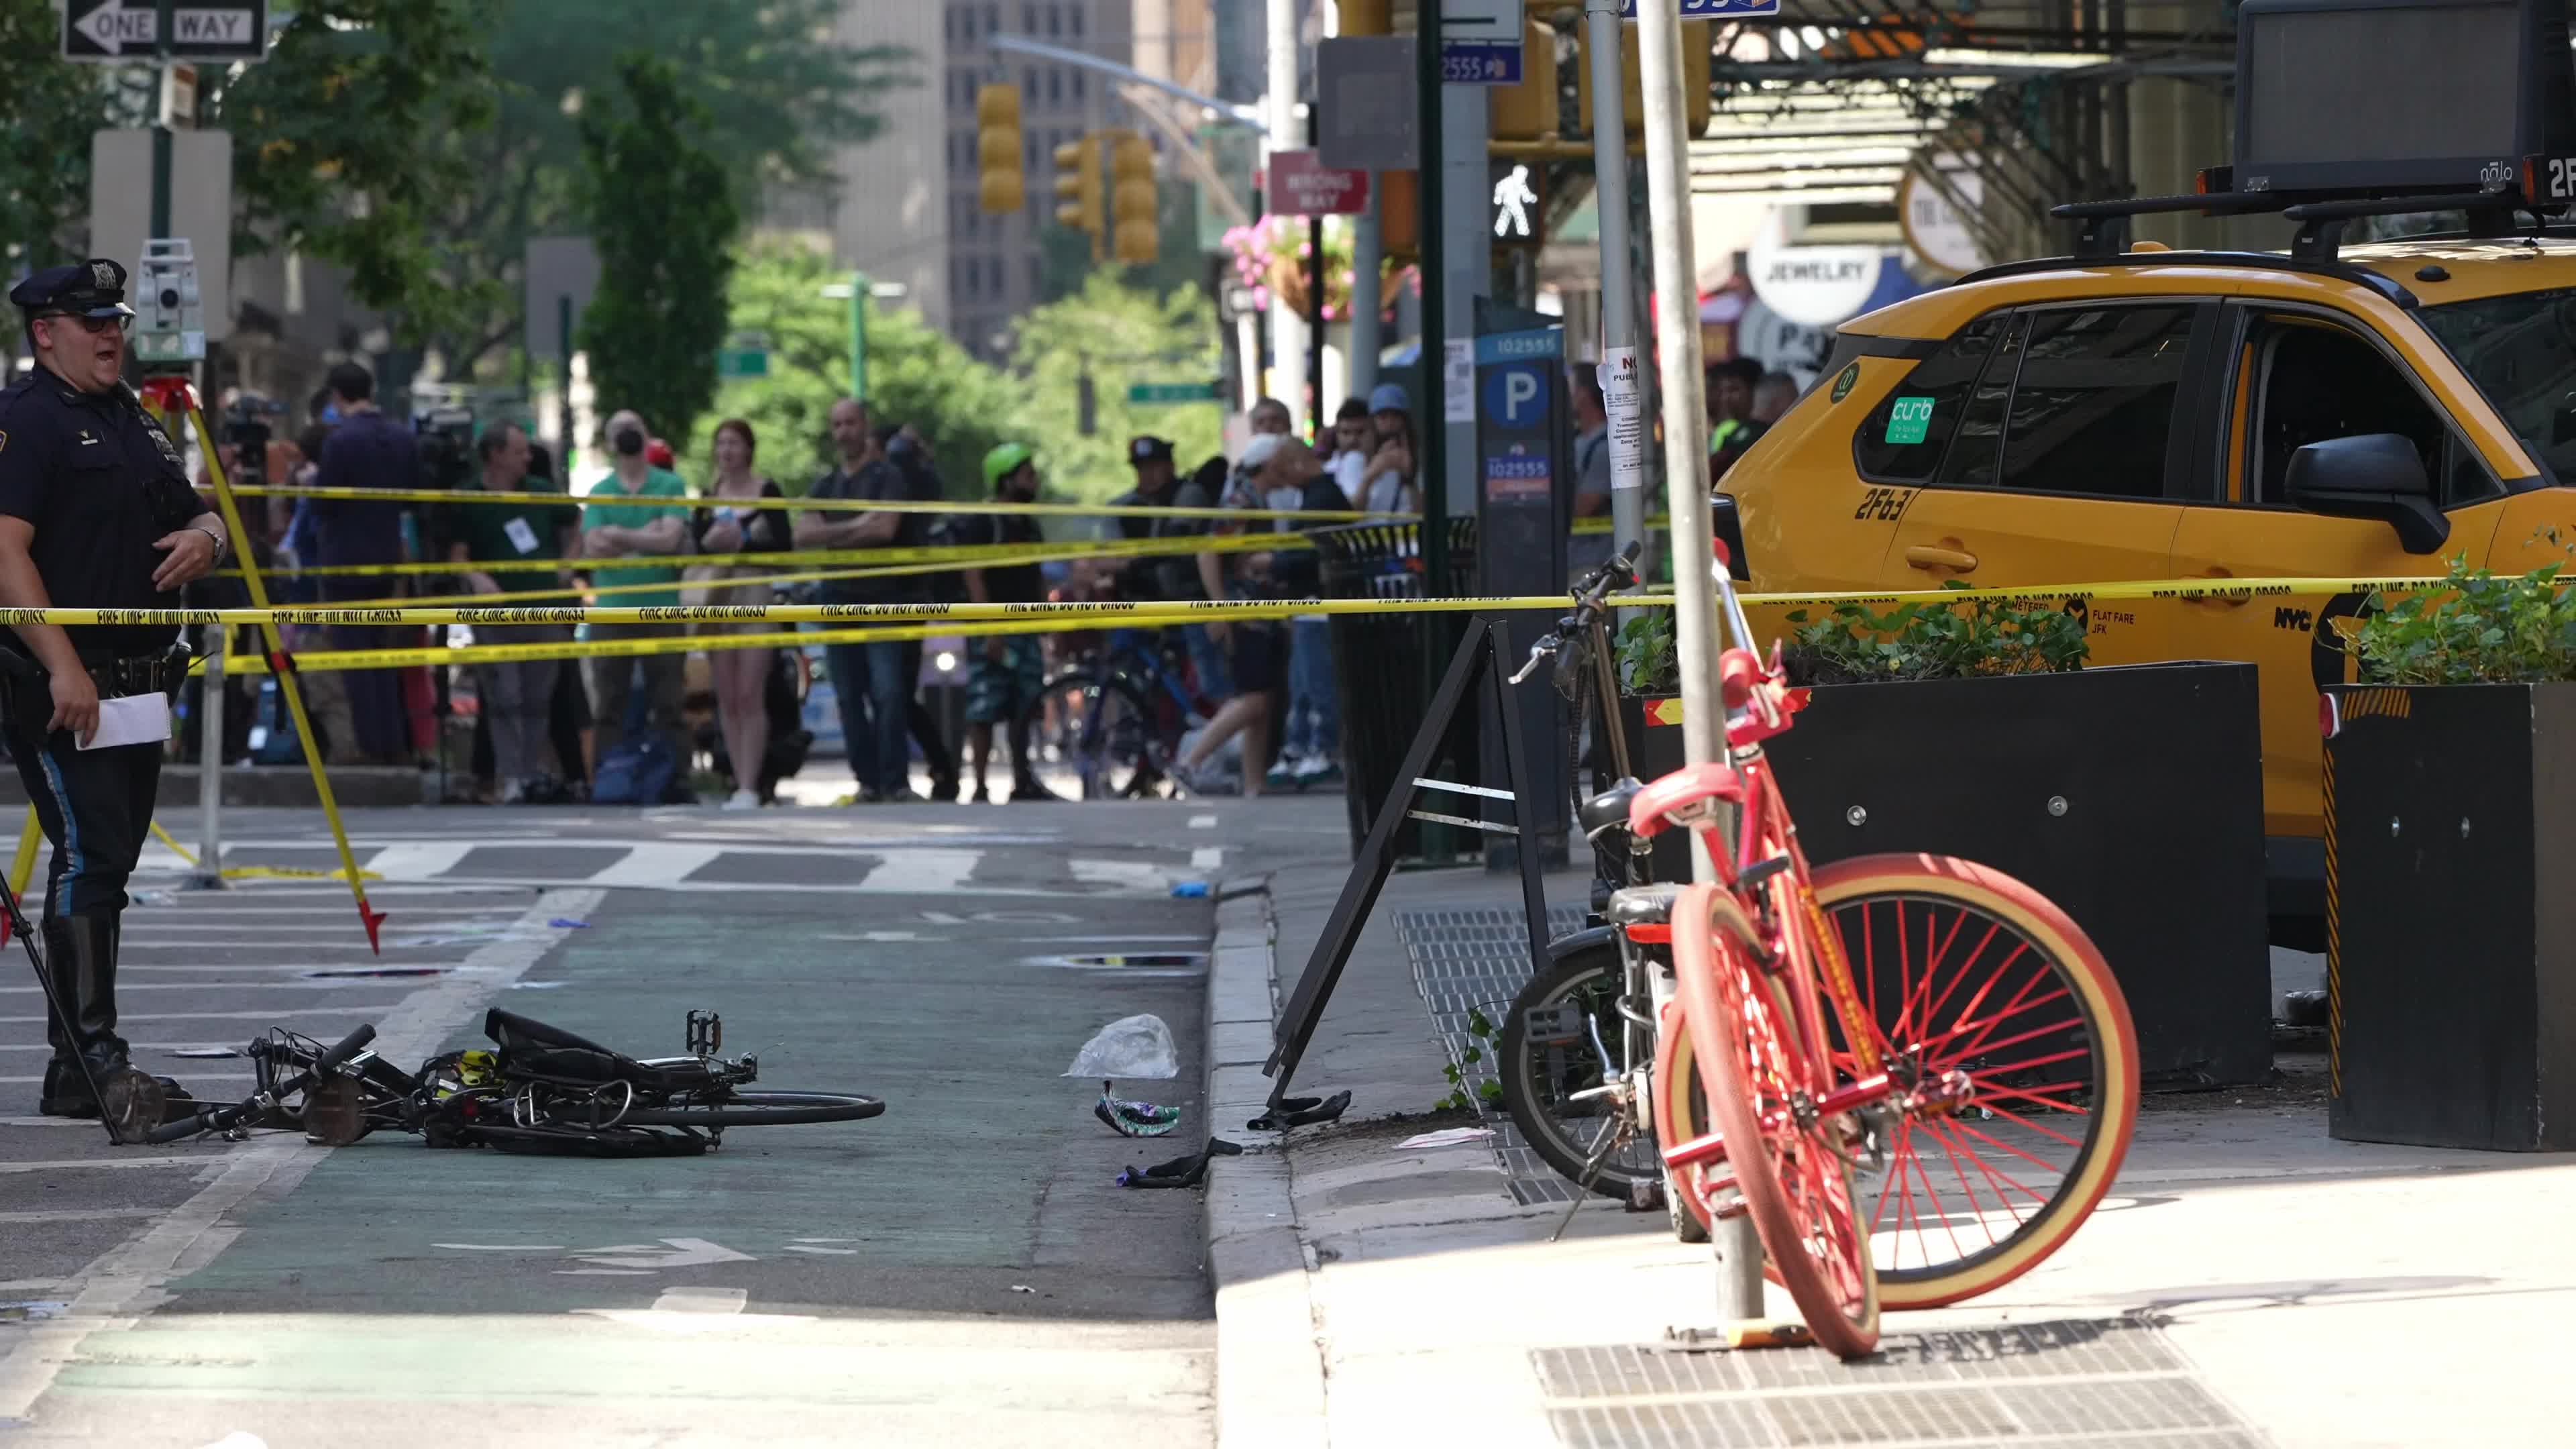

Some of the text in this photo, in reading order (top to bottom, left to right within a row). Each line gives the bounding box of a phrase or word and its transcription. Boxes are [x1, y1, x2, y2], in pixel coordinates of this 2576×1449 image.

[96, 13, 239, 38] ONE WAY
[1442, 56, 1481, 79] 2555
[1286, 172, 1352, 192] WRONG
[2549, 158, 2576, 197] 2F
[1299, 194, 1338, 209] WAY
[1767, 260, 1867, 282] JEWELRY
[1498, 337, 1556, 355] 102555
[1505, 372, 1538, 421] P
[1892, 400, 1932, 421] curb
[1487, 461, 1547, 477] 102555
[1854, 488, 1911, 521] 2F63
[2092, 610, 2135, 625] FLAT FARE
[2274, 606, 2312, 631] NYC
[2092, 624, 2107, 635] JFK
